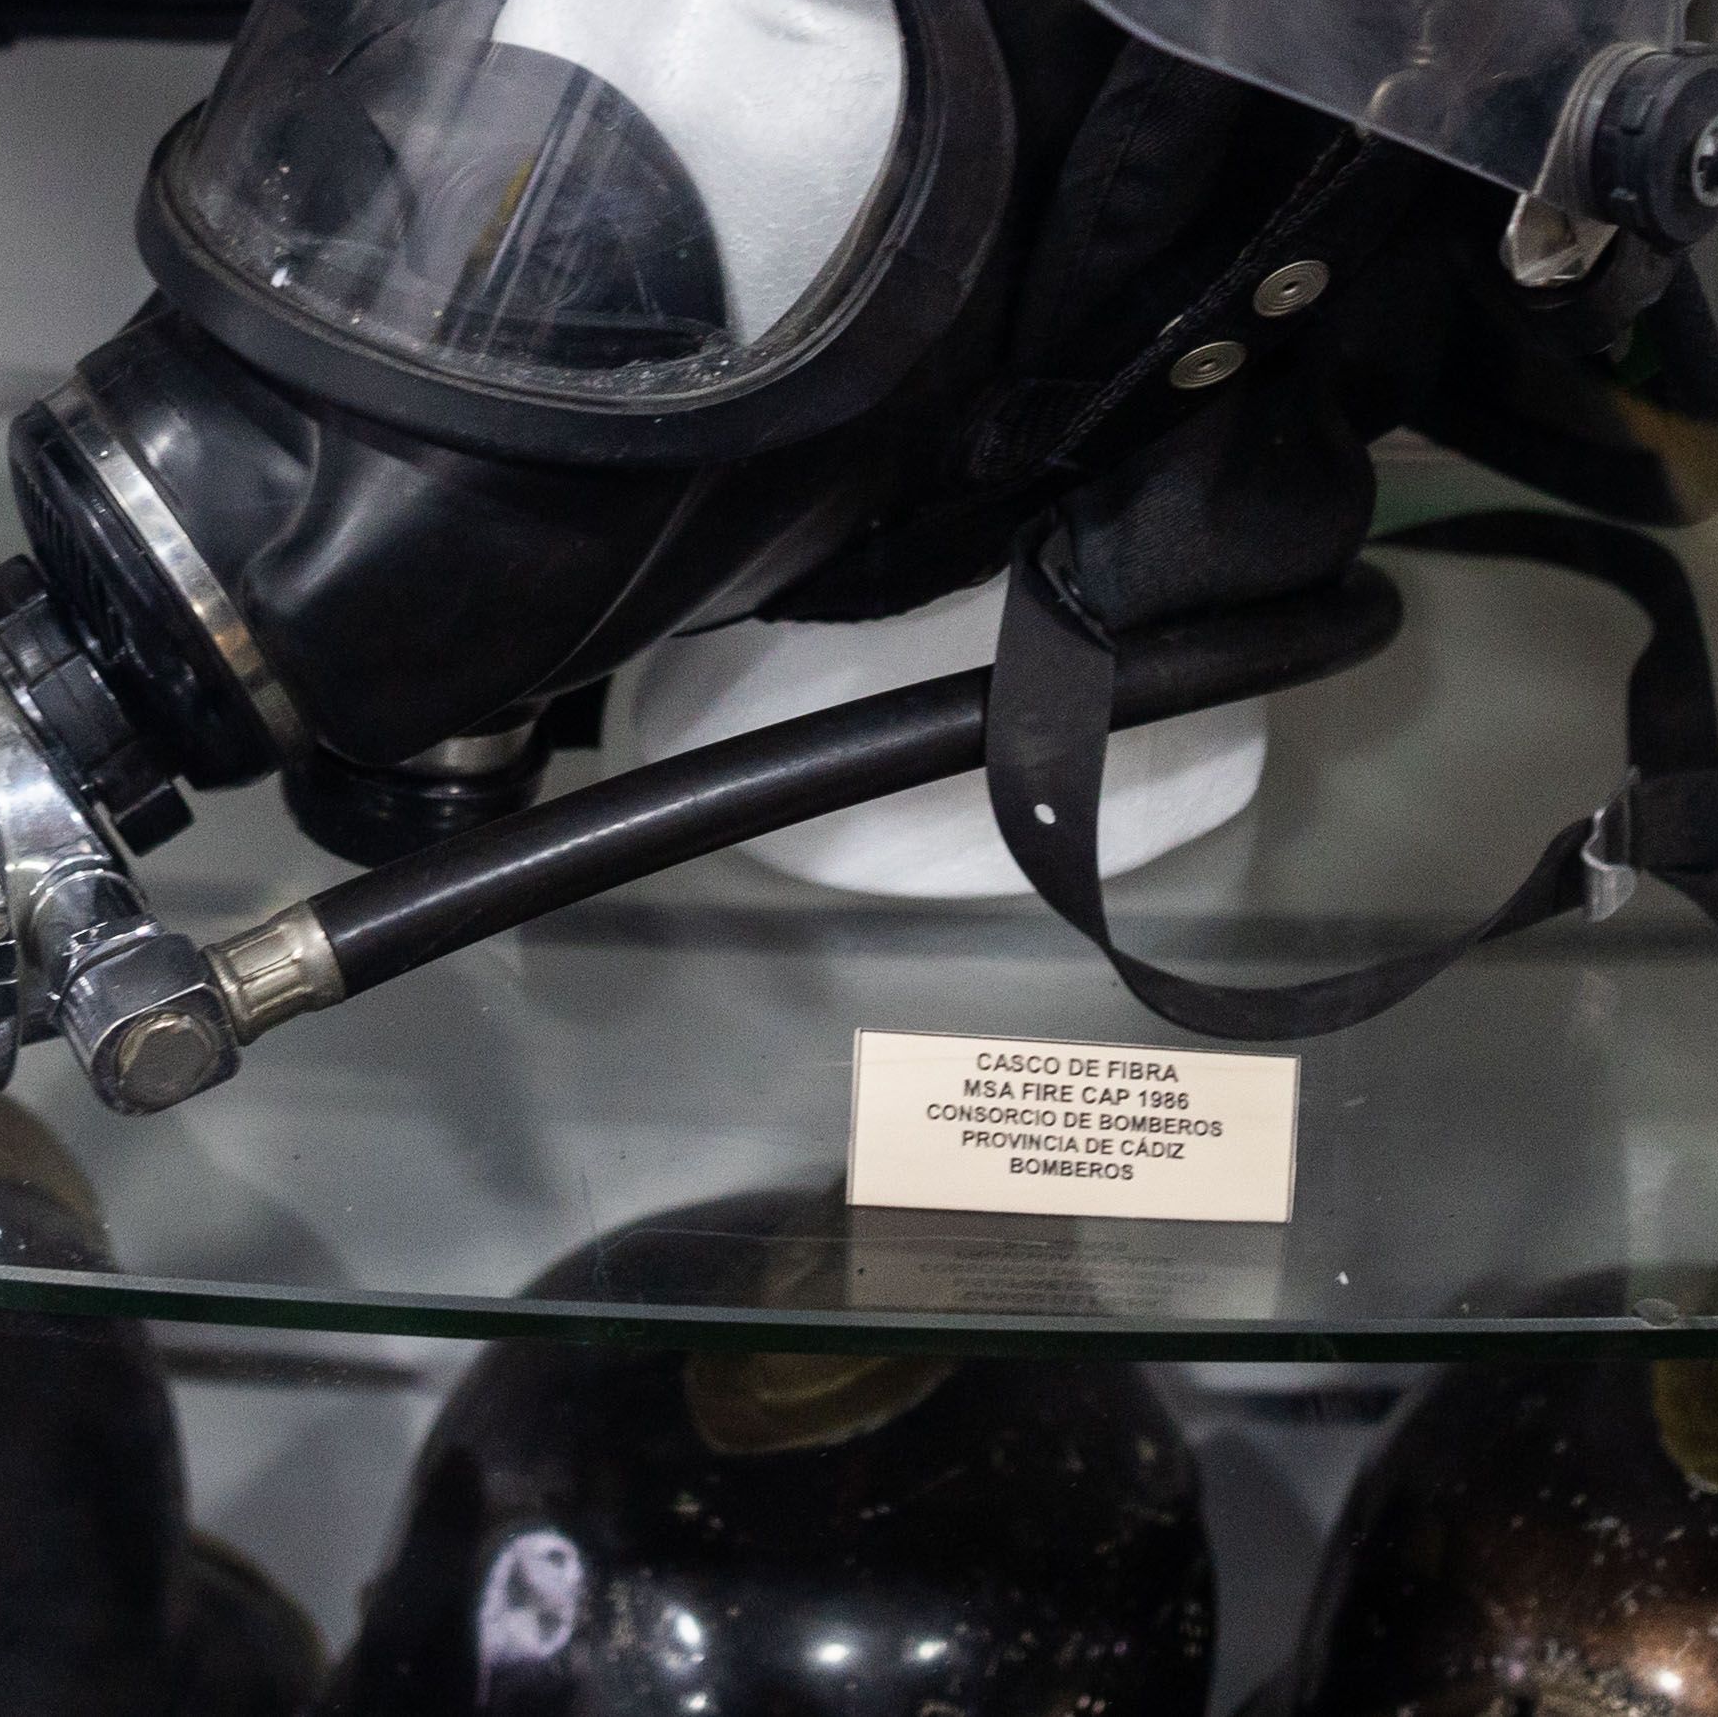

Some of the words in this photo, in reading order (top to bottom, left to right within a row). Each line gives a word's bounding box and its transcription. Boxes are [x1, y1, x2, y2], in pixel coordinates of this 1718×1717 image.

[976, 1054, 1062, 1075] CASCO
[1067, 1059, 1100, 1077] DE
[1106, 1061, 1180, 1082] FIBRA
[963, 1080, 1016, 1098] MSA
[1021, 1083, 1074, 1103] FIRE
[1080, 1086, 1131, 1105] CAP
[1137, 1090, 1191, 1110] 1986
[925, 1104, 1058, 1126] CONSORCIO
[1062, 1111, 1093, 1129] DE
[1098, 1114, 1224, 1137] BOMBEROS
[961, 1130, 1081, 1152] PROVINCIA
[1084, 1137, 1114, 1155] DE
[1119, 1137, 1186, 1159] CÁDIZ
[1008, 1157, 1135, 1180] BOMBEROS
